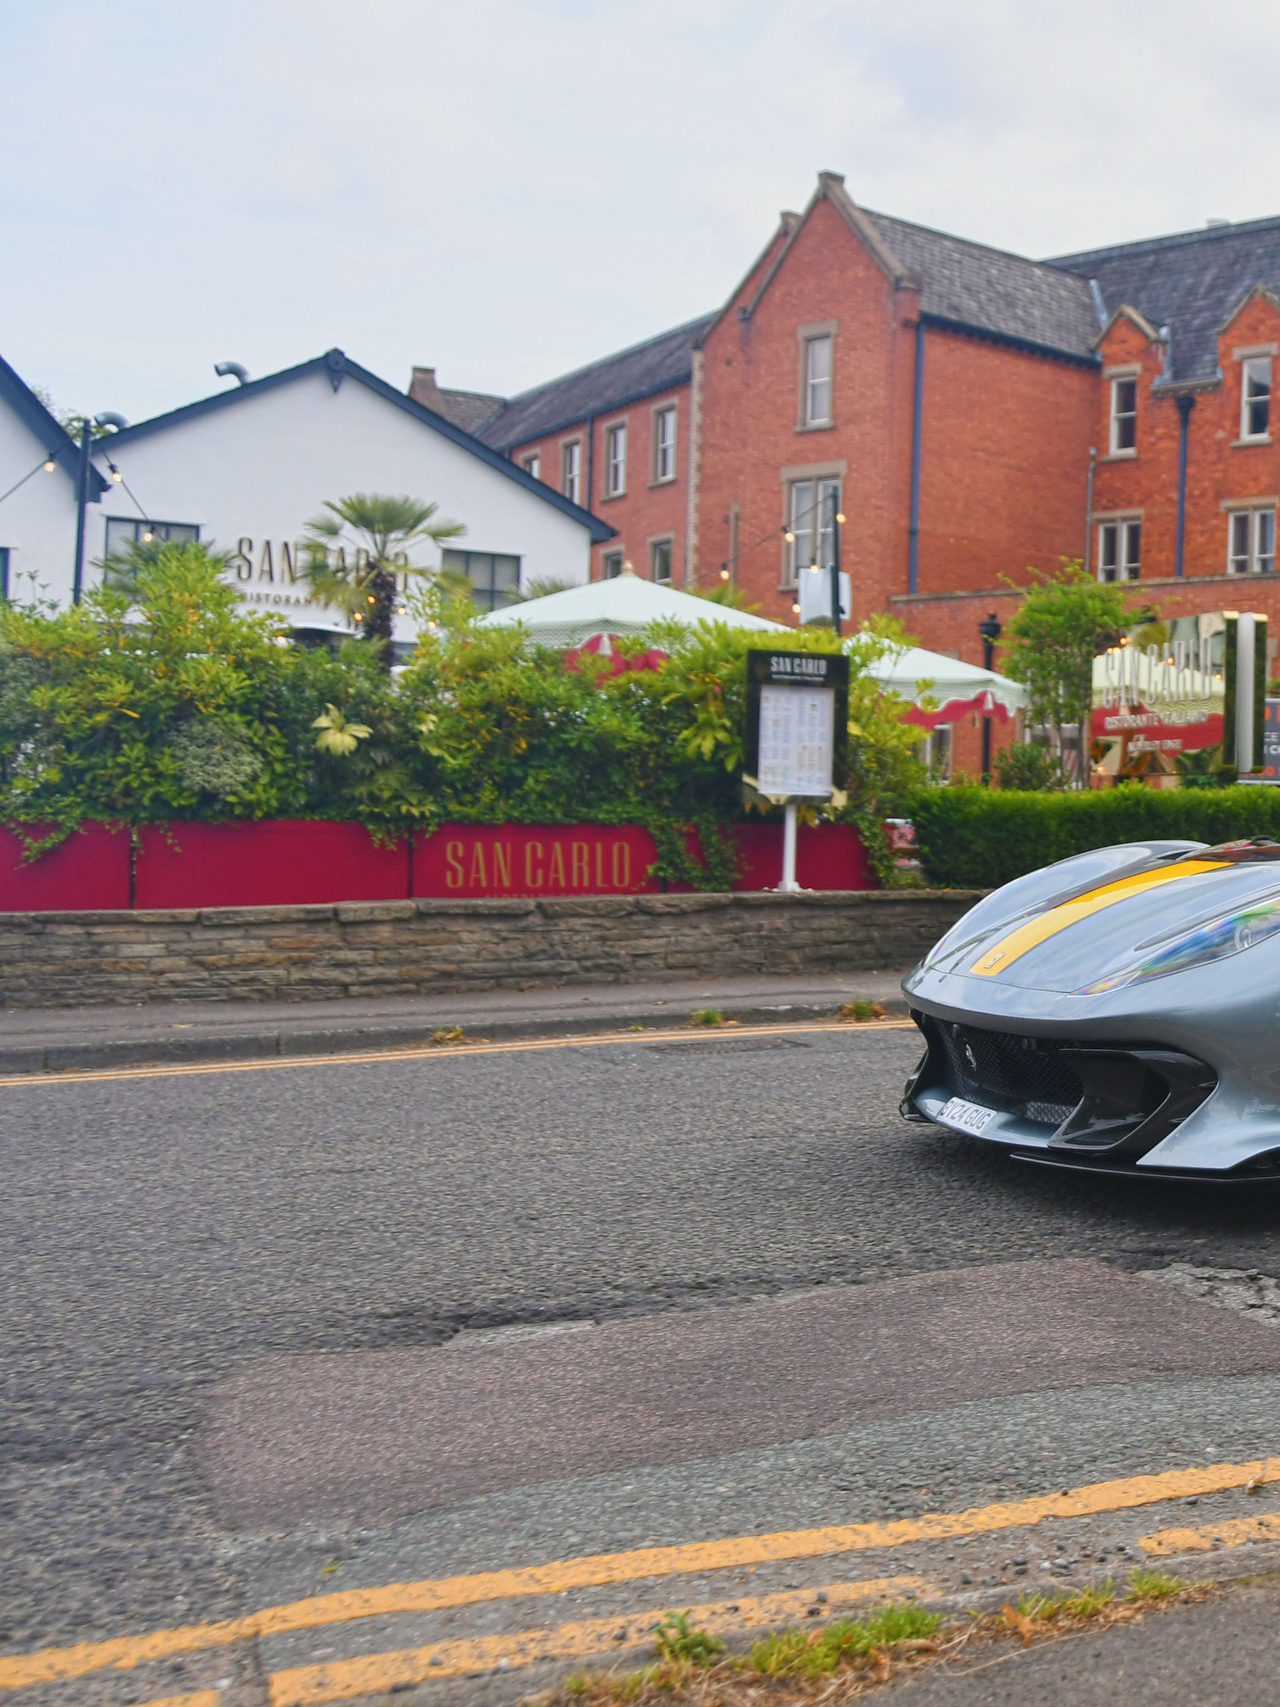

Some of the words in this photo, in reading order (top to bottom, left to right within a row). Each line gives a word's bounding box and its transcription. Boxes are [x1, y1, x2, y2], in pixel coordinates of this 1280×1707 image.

[237, 536, 299, 584] SAN
[770, 656, 793, 673] SAN
[793, 657, 827, 675] CARLO
[1103, 645, 1140, 710] SAN
[1146, 637, 1213, 705] CARLO
[445, 841, 512, 889] SAN
[525, 841, 631, 889] CARLO
[963, 1107, 992, 1131] GUG
